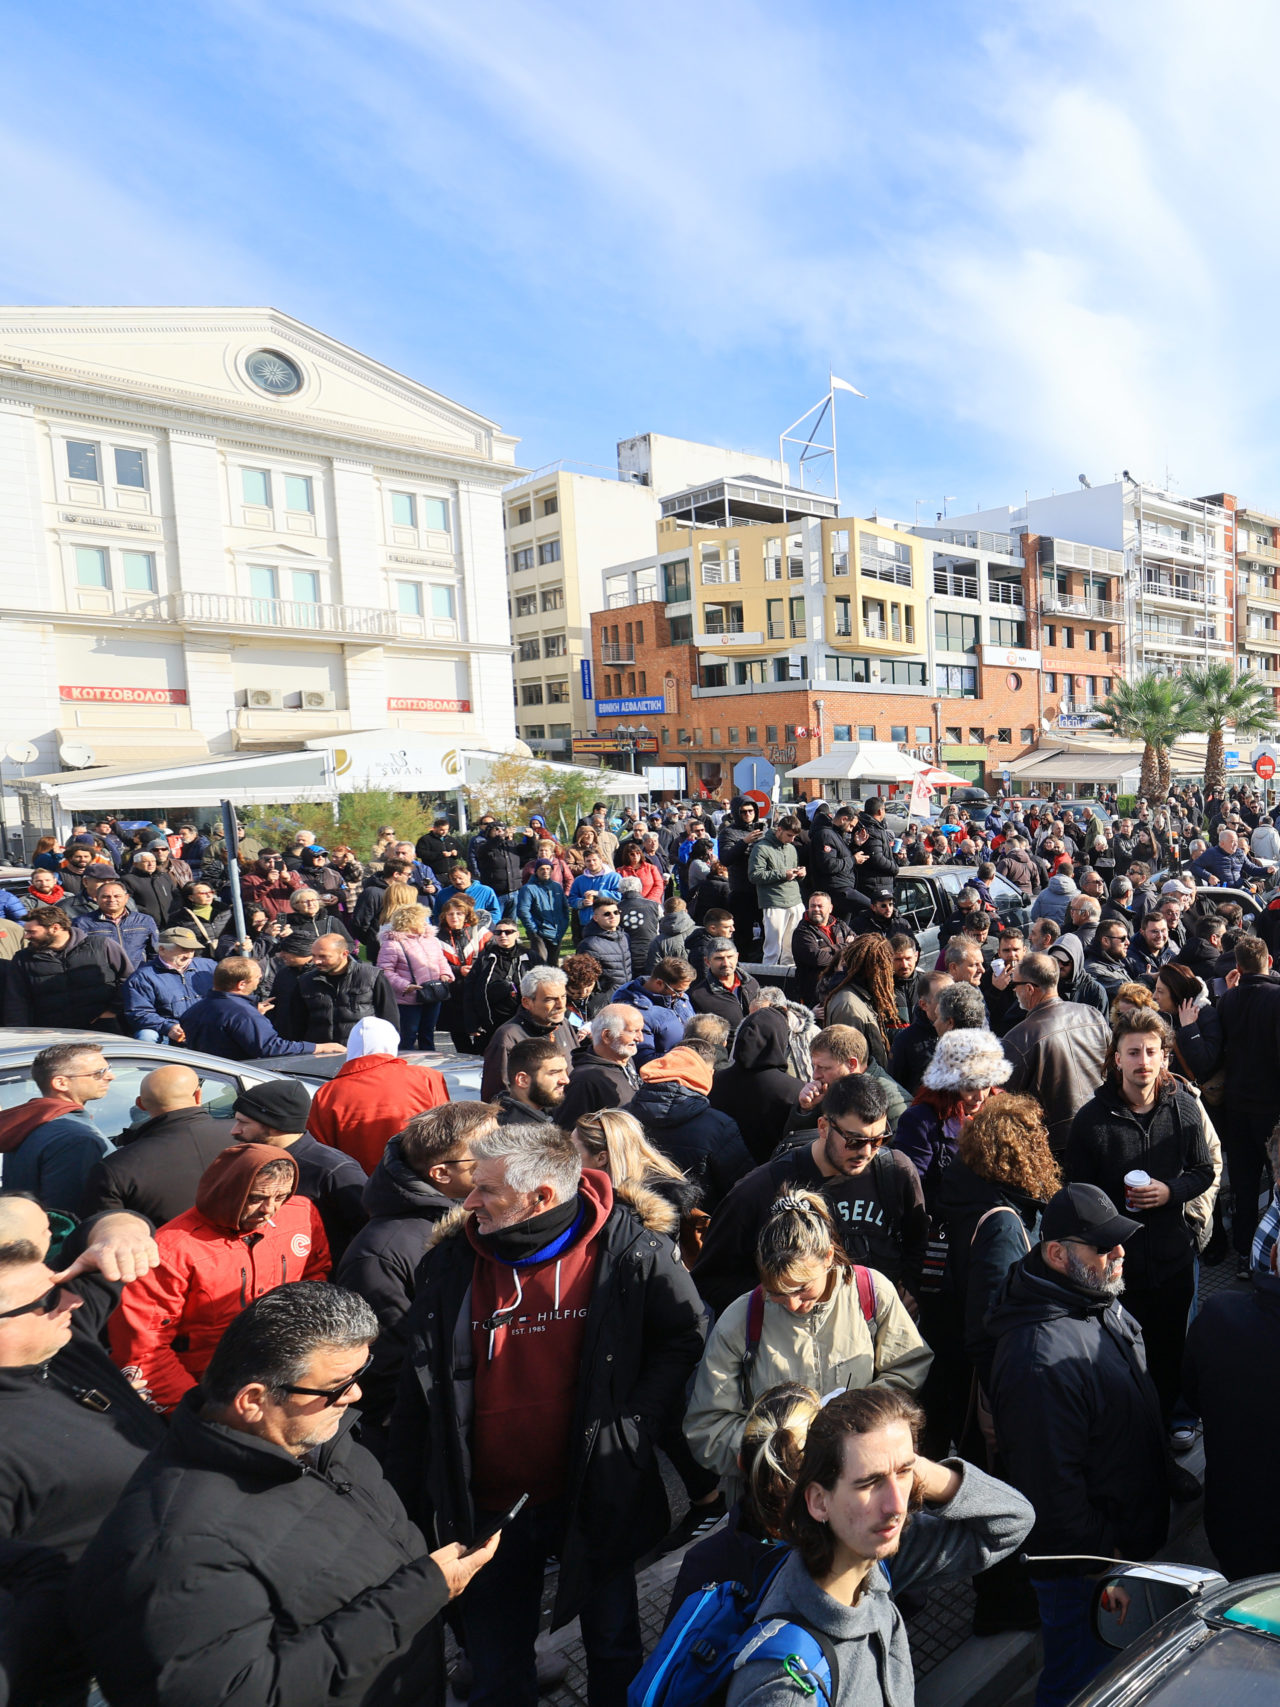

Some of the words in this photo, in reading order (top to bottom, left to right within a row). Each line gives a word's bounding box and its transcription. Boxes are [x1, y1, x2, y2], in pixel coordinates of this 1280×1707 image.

[71, 687, 174, 703] ΚΩΤΣΟΒΟΛΟΣ
[389, 699, 463, 712] ΚΩΤΣΟΒΟΛΟΣ
[598, 702, 620, 713] ΕΘΝΙΚΗ
[621, 699, 662, 712] ΑΣΦΑΛΙΣΤΙΚΗ
[382, 767, 422, 776] SWAN
[538, 1309, 588, 1322] HILFIG
[528, 1325, 546, 1334] 1985
